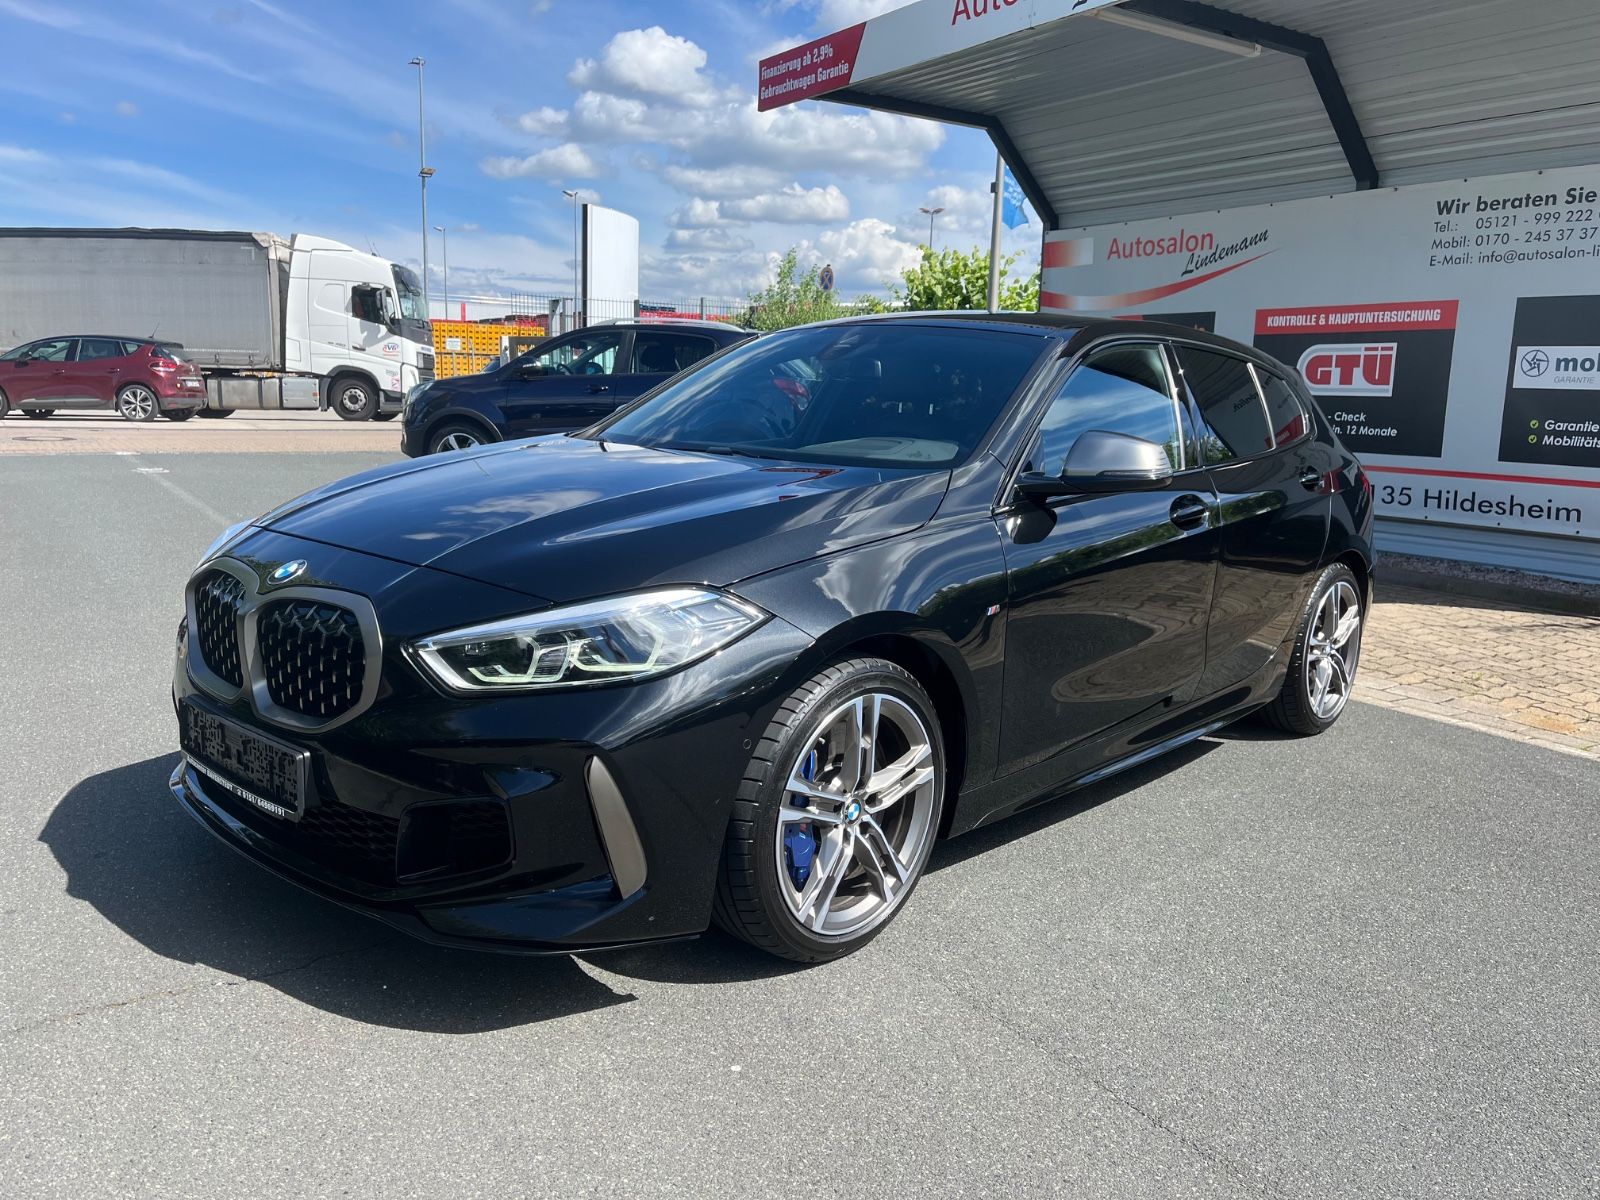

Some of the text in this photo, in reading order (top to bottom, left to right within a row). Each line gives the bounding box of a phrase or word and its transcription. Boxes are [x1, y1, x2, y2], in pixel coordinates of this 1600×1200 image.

[761, 43, 834, 80] Finanzierung ab 2,9%
[760, 60, 849, 99] Gebrauchtwagen Garantie
[1436, 186, 1598, 216] Wir beraten Sie
[1434, 221, 1458, 233] Tel.:
[1476, 215, 1517, 229] 05121
[1534, 211, 1561, 225] 999
[1566, 209, 1593, 222] 222
[1107, 228, 1214, 260] Autosalon
[1431, 236, 1470, 250] Mobil:
[1475, 233, 1510, 247] 0170
[1524, 230, 1551, 243] 245
[1556, 228, 1574, 241] 37
[1579, 227, 1598, 240] 37
[1181, 229, 1269, 277] Lindemann
[1429, 253, 1473, 266] E-Mail:
[1267, 309, 1441, 327] KONTROLLE & HAUPTUNTERSUCHUNG
[1305, 346, 1394, 386] GTÜ
[1554, 376, 1595, 384] GARANTIE
[1334, 411, 1367, 422] Check
[1544, 420, 1600, 432] Garantie
[1346, 425, 1357, 435] 12
[1358, 426, 1398, 437] Monate
[1423, 488, 1582, 523] Hildesheim
